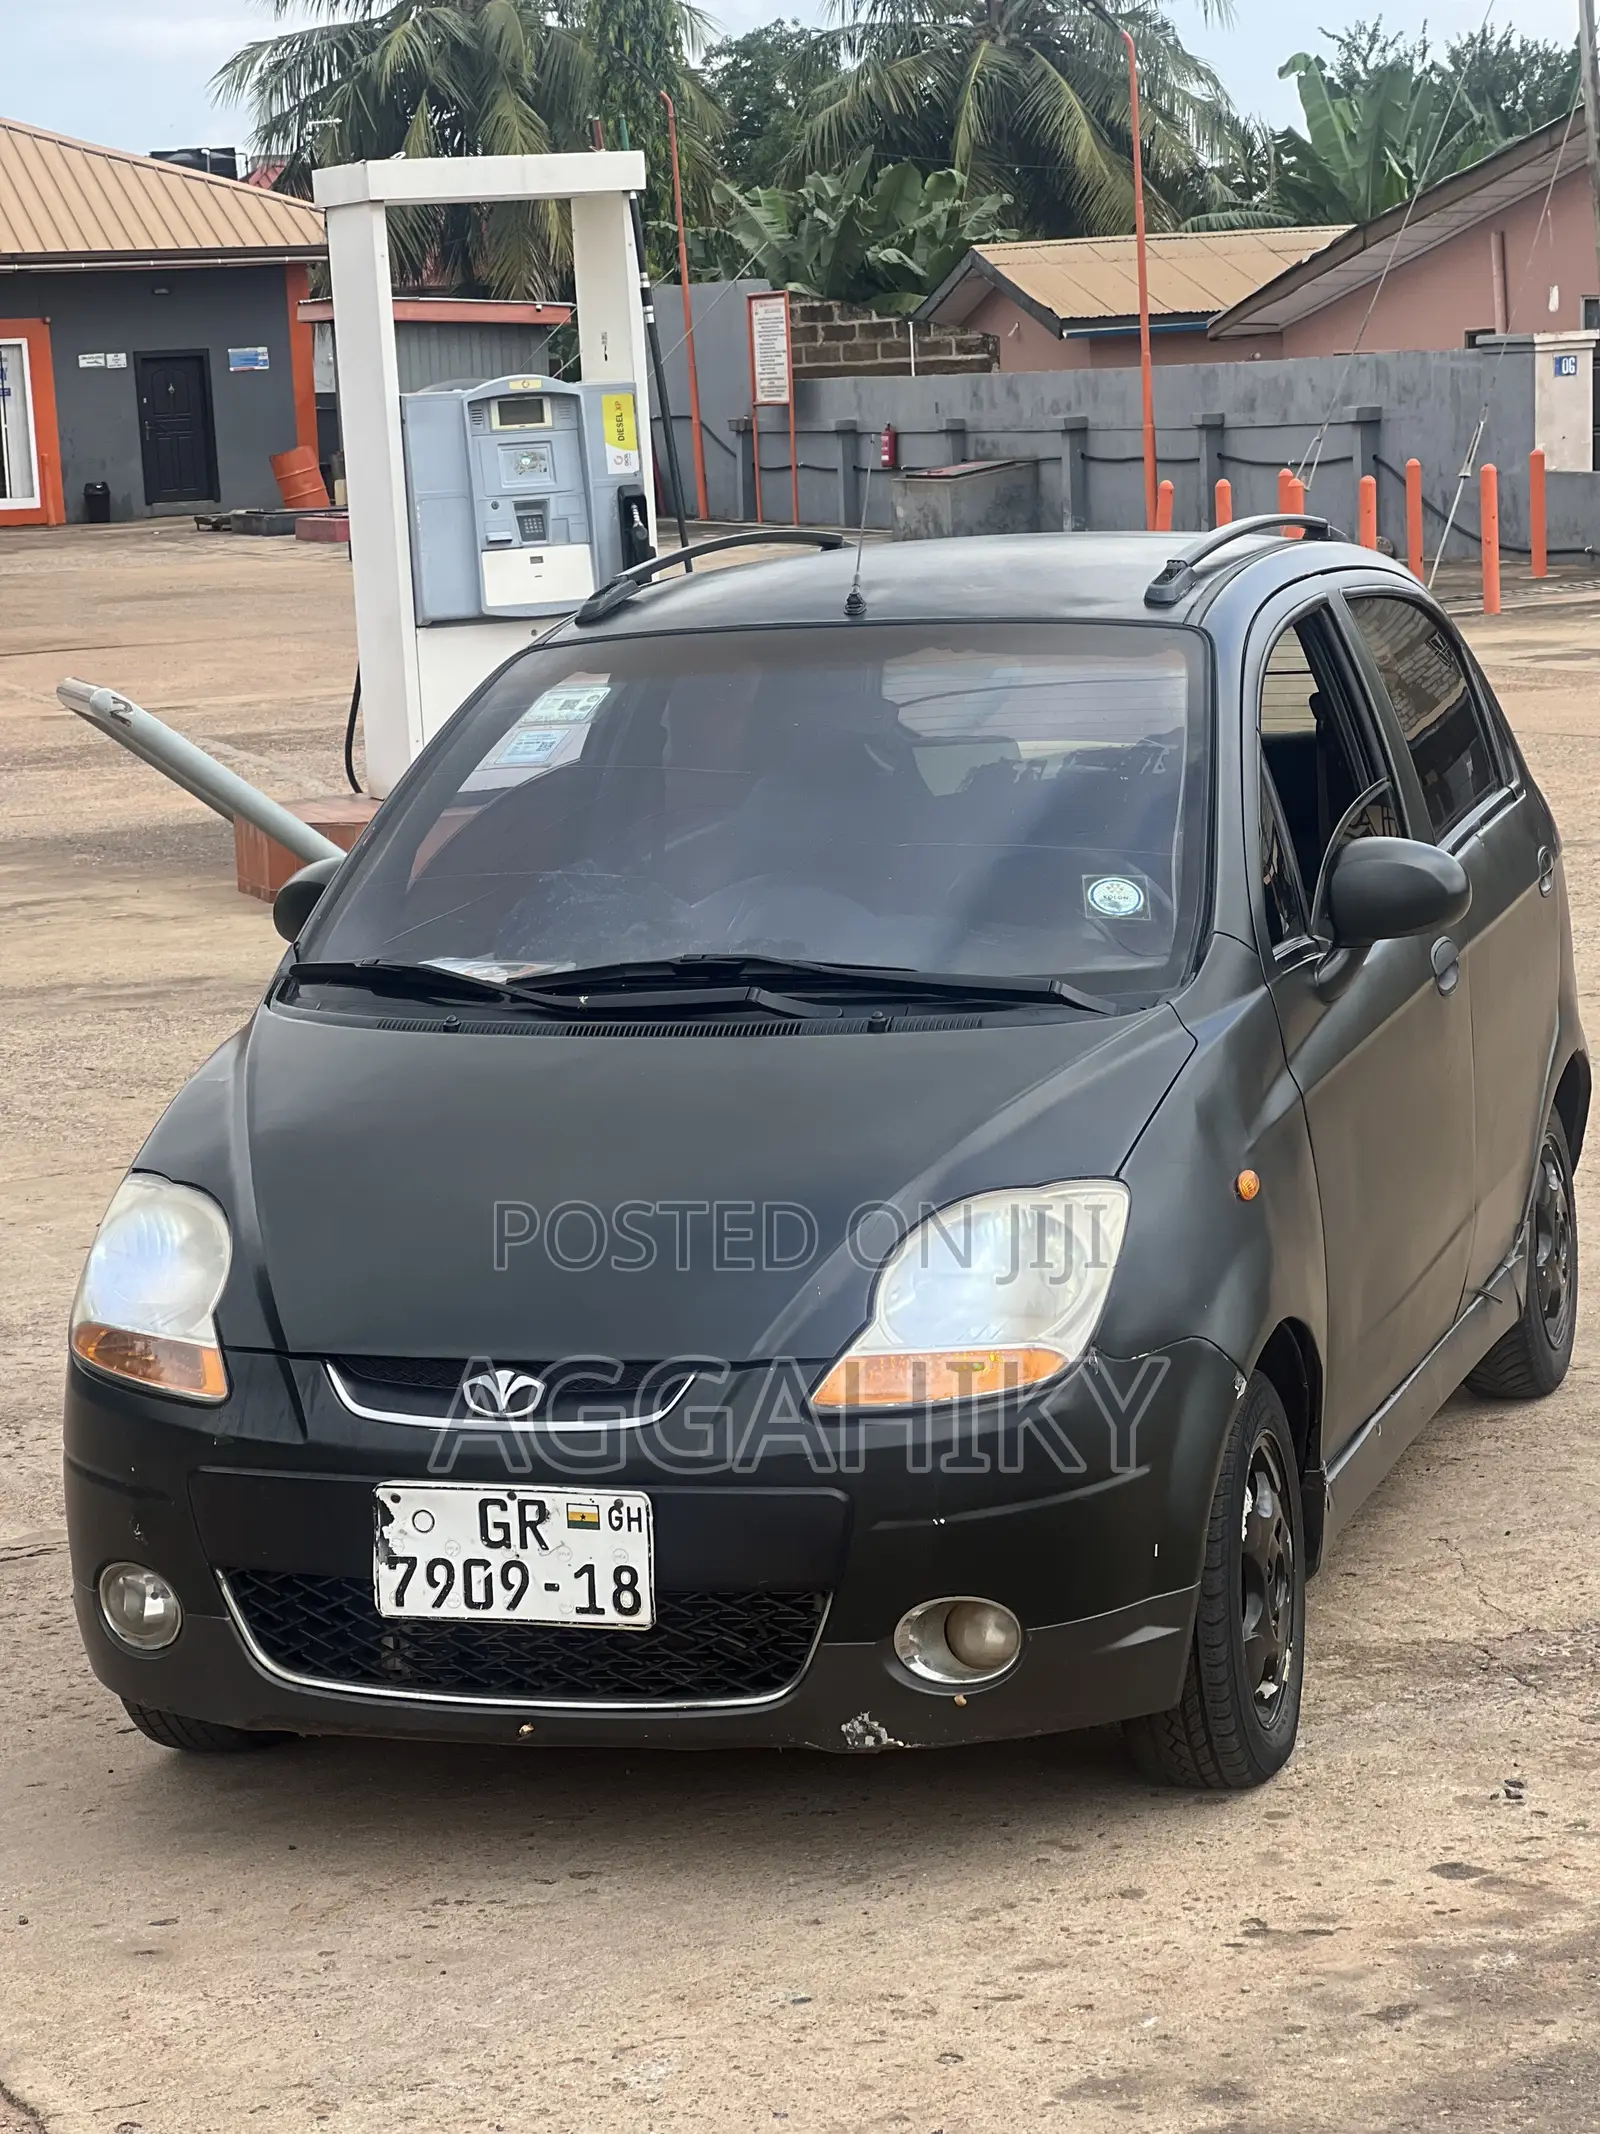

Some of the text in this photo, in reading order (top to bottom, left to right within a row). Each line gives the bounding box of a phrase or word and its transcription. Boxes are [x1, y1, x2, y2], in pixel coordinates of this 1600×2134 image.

[1562, 357, 1575, 374] 06
[615, 400, 625, 442] DIESEL XP
[109, 695, 134, 728] 2
[479, 1498, 643, 1550] GR GH
